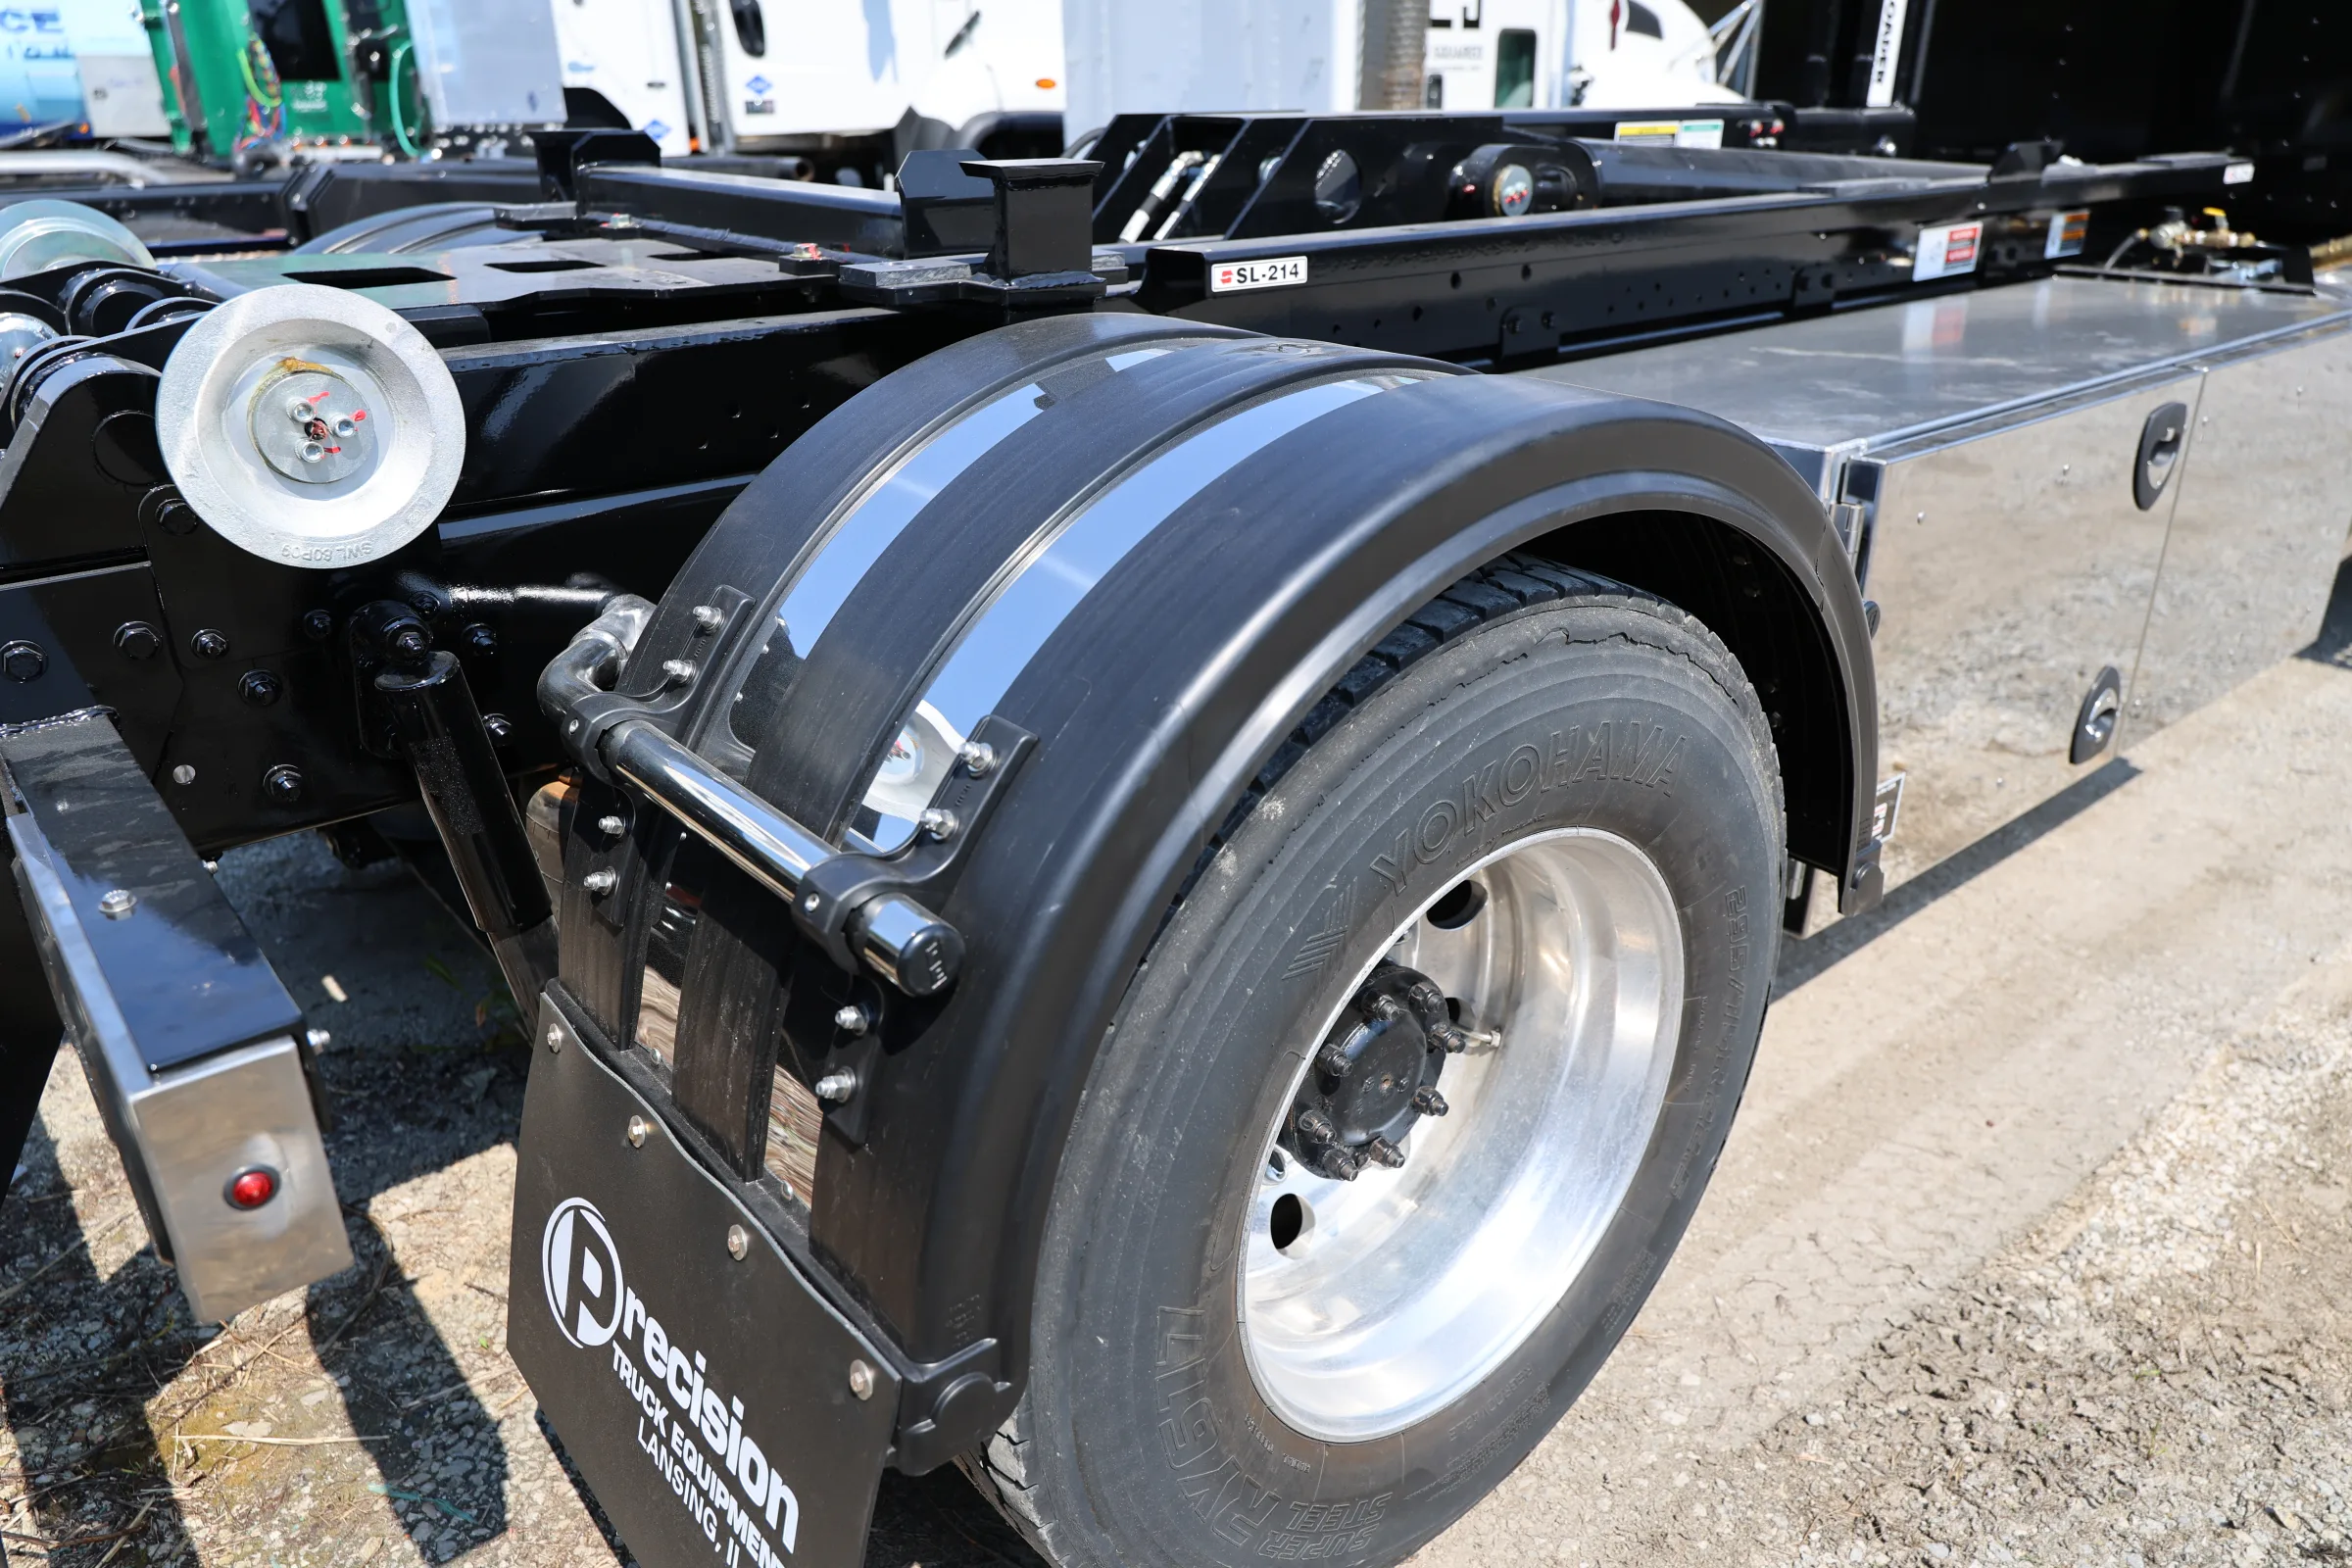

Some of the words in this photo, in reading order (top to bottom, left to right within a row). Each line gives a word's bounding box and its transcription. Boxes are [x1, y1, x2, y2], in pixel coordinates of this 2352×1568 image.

[1236, 263, 1299, 284] SL-214
[1369, 720, 1688, 898] YOKOHAMA
[542, 1197, 800, 1555] Precision
[612, 1339, 669, 1439] TRUCK
[671, 1420, 786, 1568] EQUIPMEN
[637, 1416, 722, 1553] LANSING,
[1286, 1492, 1394, 1533] STEEL
[1256, 1522, 1381, 1561] SUPER
